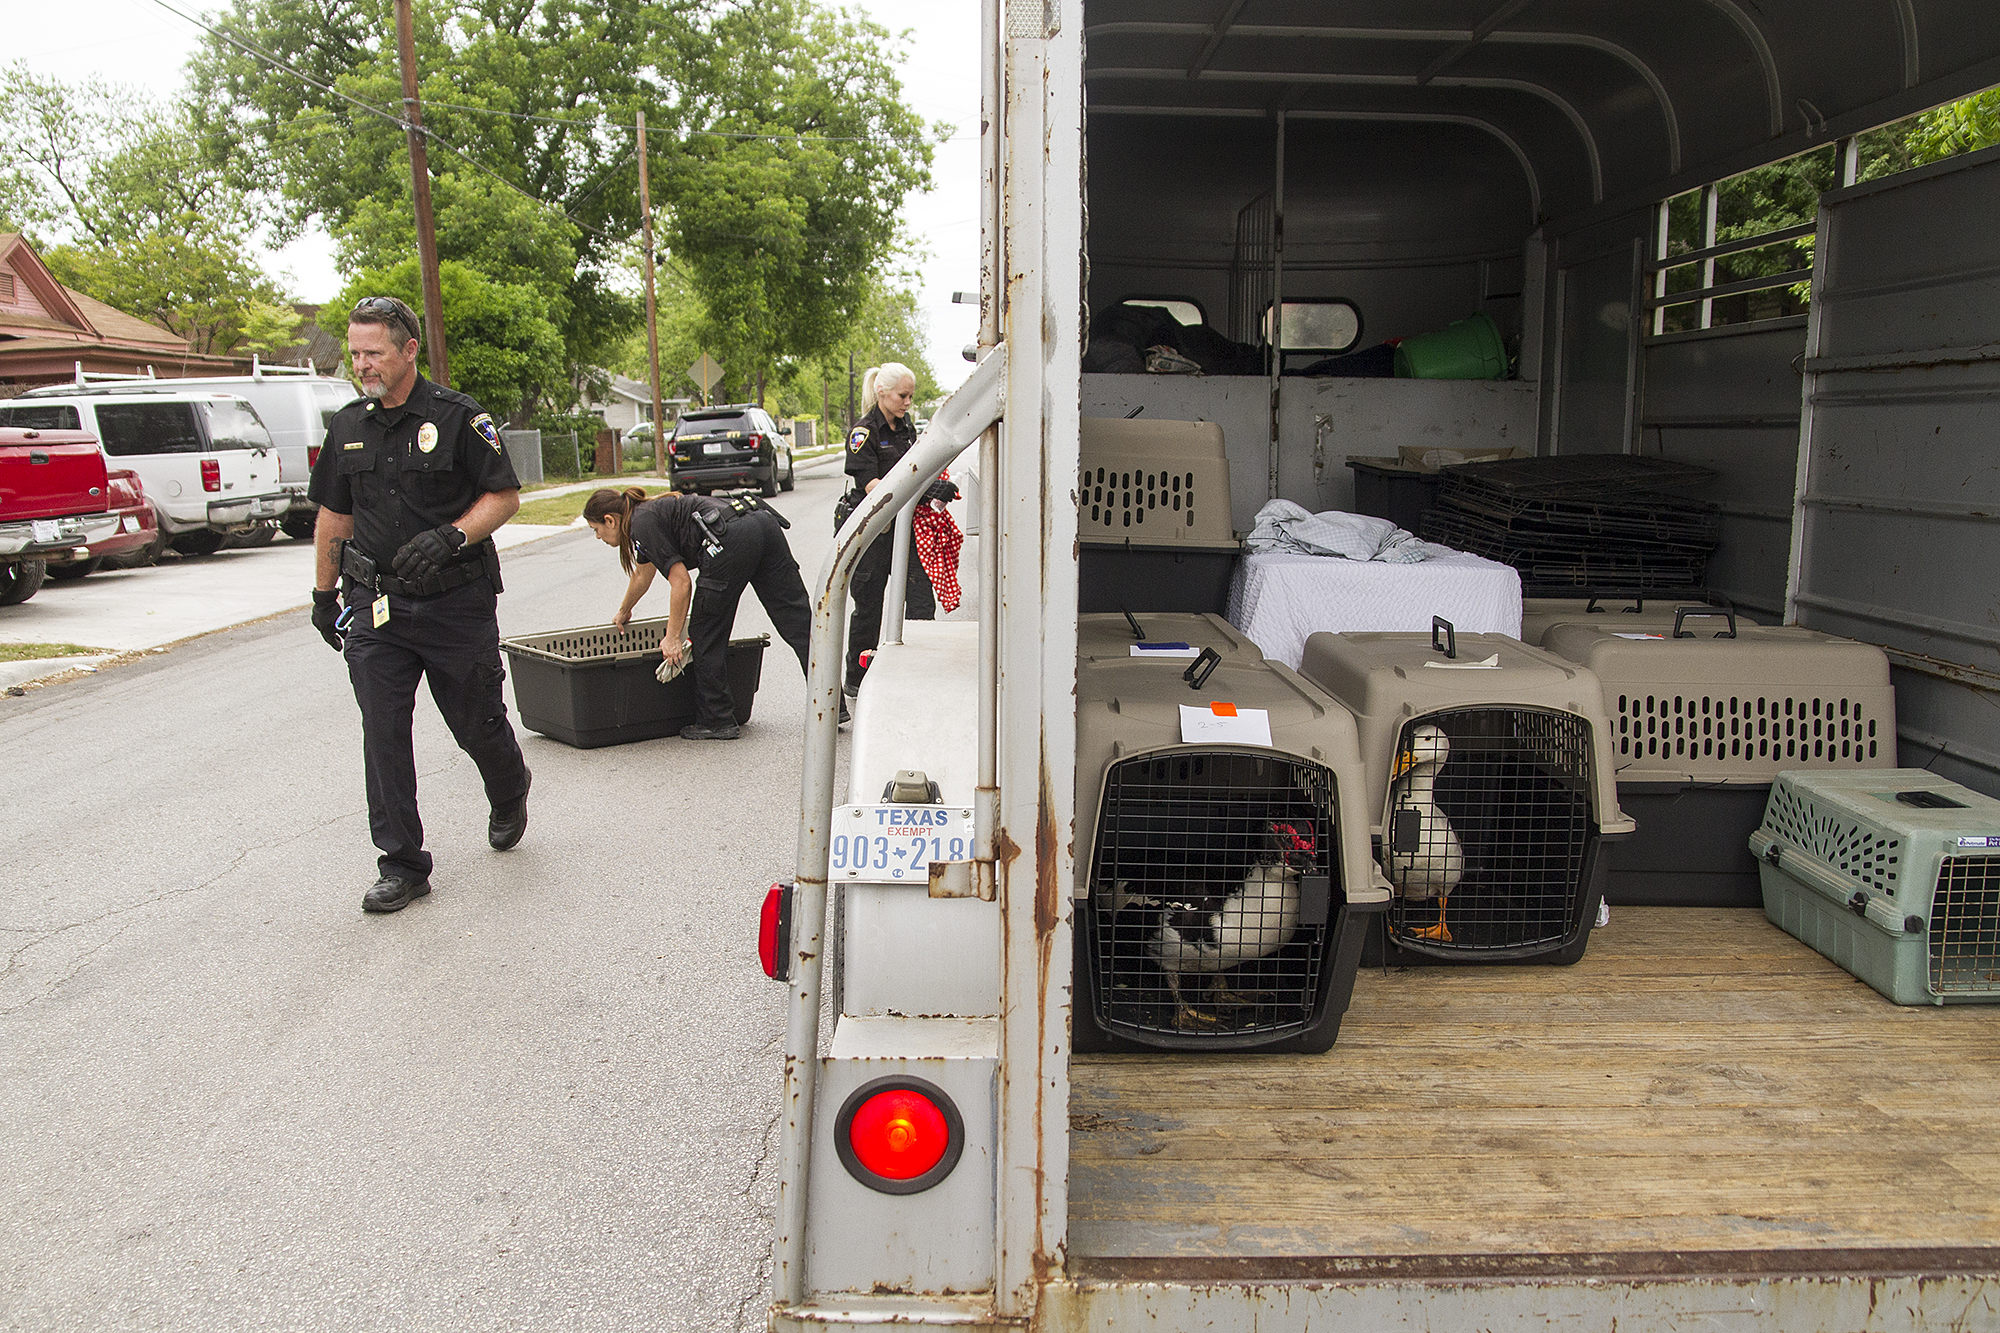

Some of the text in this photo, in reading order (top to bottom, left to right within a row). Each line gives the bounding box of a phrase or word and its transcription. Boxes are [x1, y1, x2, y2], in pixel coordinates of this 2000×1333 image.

[677, 434, 703, 442] POLICE
[875, 810, 948, 826] TEXAS
[887, 827, 933, 837] EXEMPT
[833, 835, 975, 870] 903 218
